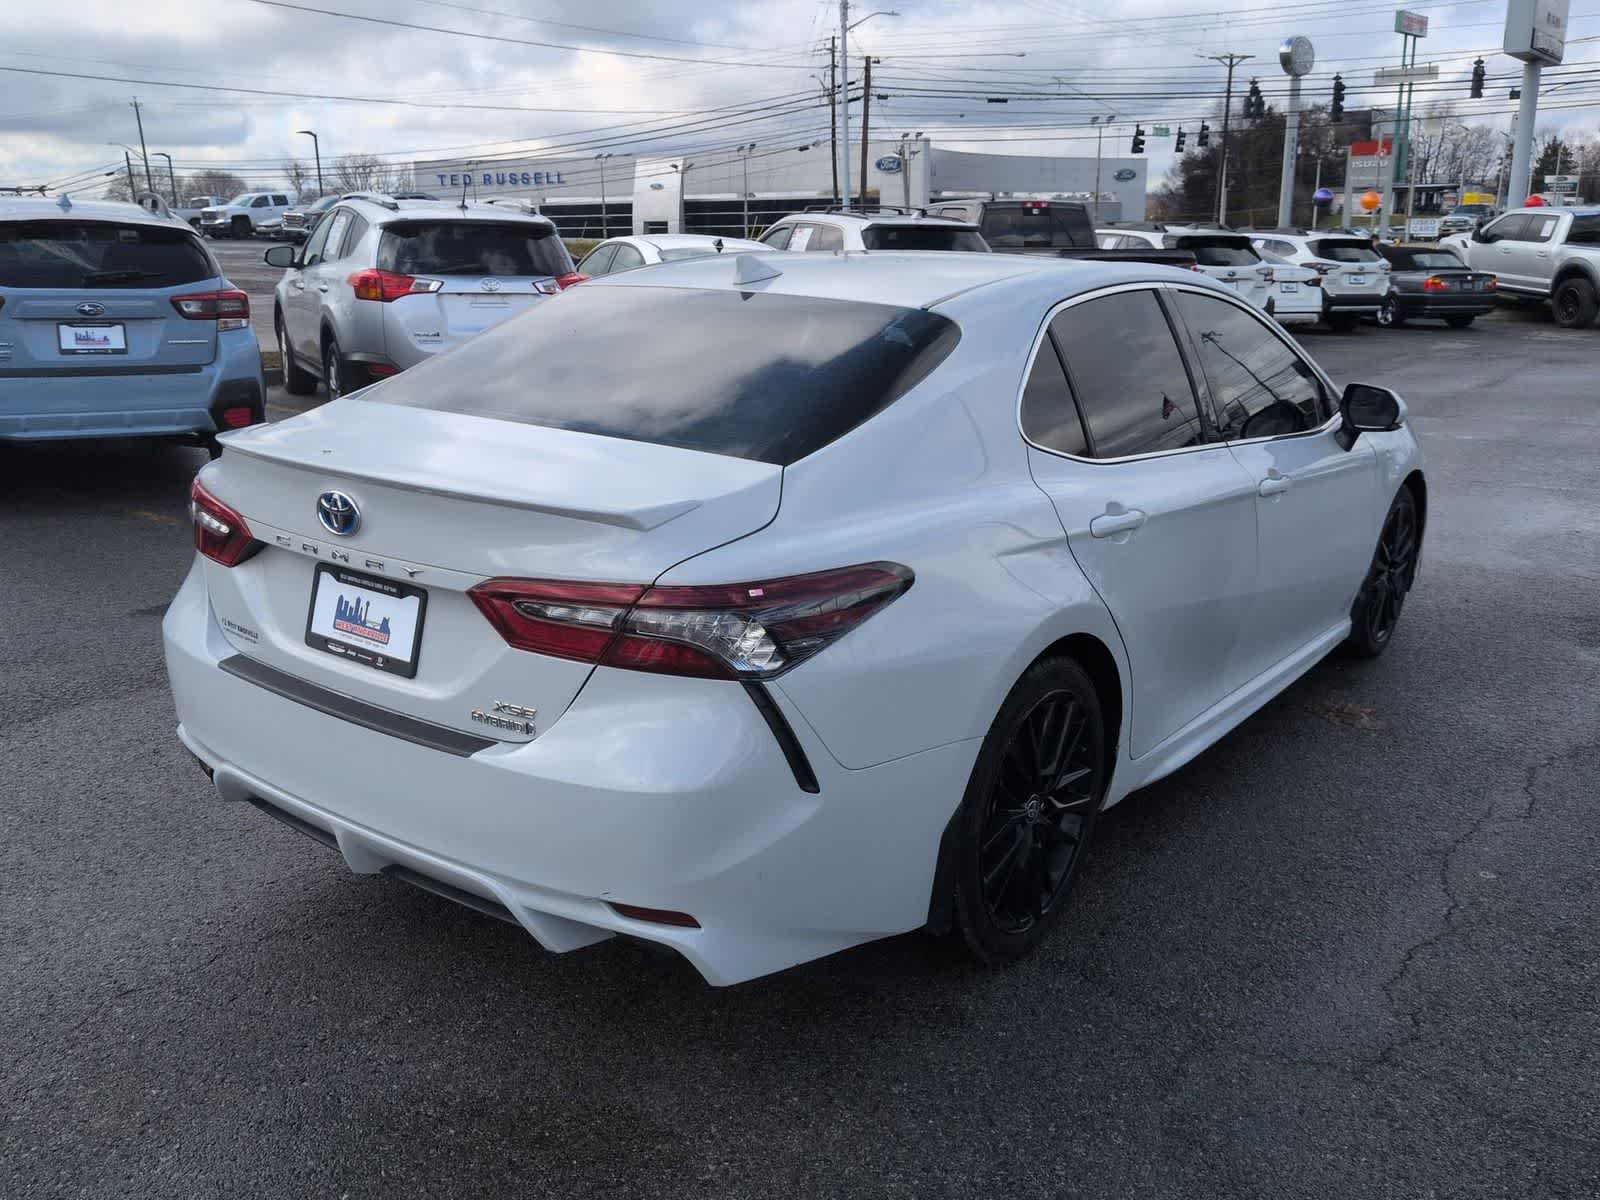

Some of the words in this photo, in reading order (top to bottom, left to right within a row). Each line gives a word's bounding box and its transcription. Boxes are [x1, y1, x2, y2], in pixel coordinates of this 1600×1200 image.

[1351, 160, 1389, 168] ISUZU
[437, 174, 472, 186] TED
[482, 172, 566, 186] RUSSELL
[276, 535, 424, 577] CAMRY
[493, 700, 537, 719] XSE
[471, 709, 526, 734] HYBRID
